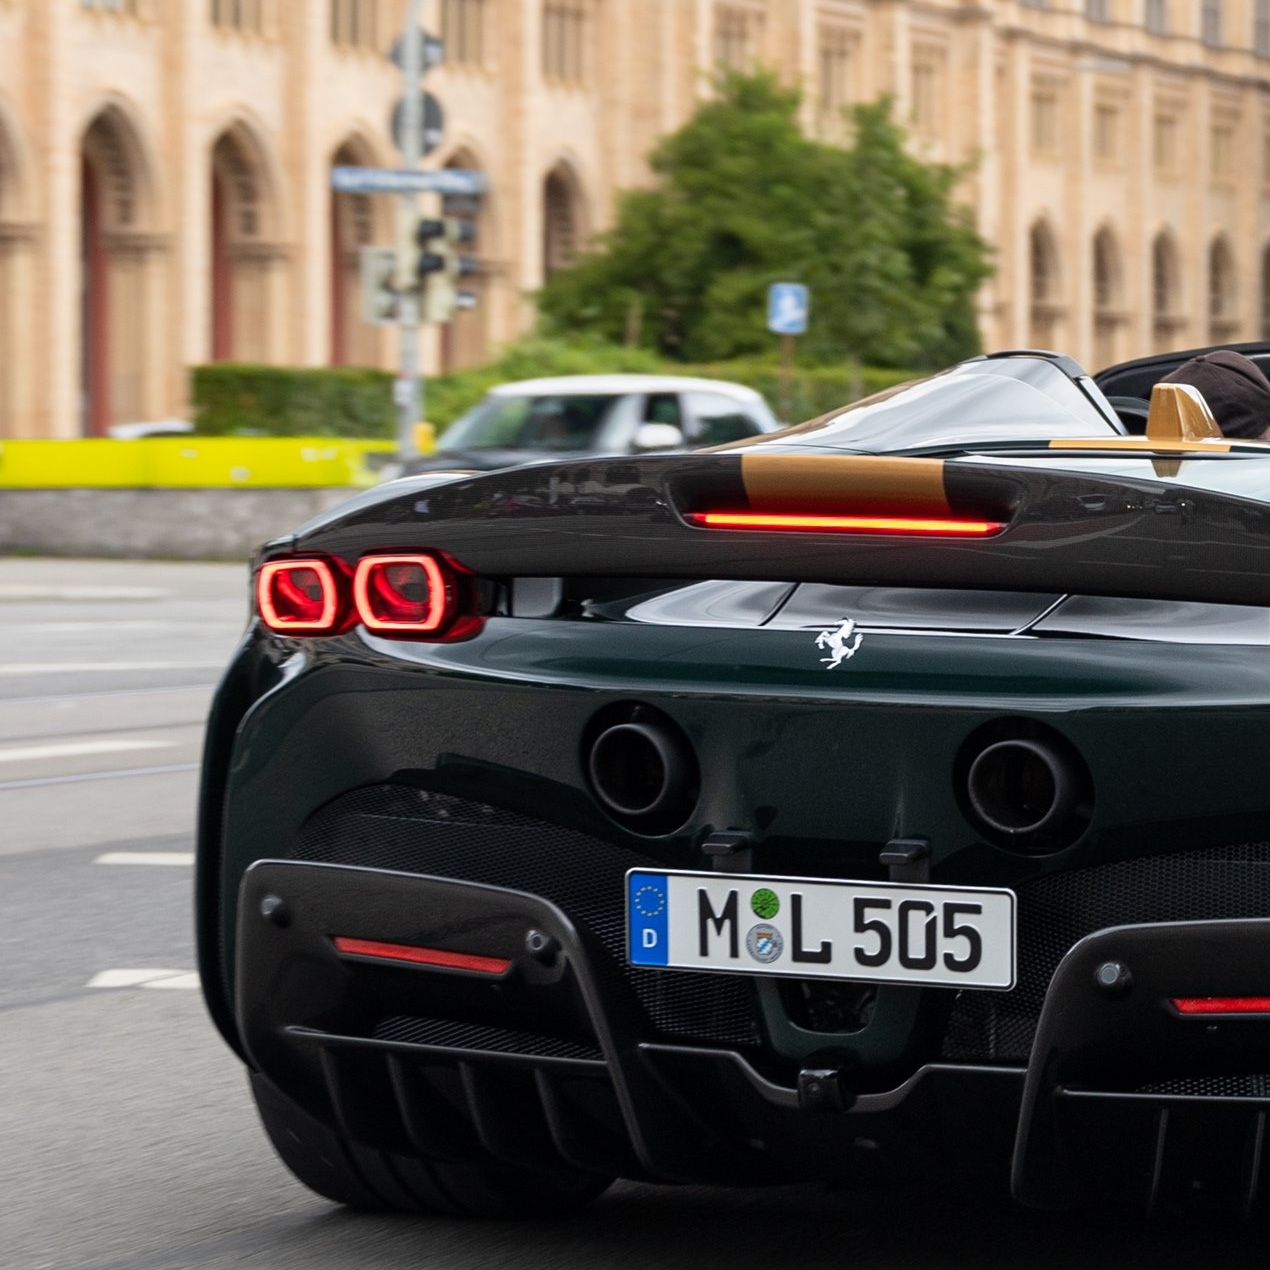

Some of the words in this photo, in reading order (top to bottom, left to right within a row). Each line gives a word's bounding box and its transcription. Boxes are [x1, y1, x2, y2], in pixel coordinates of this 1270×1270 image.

[642, 928, 658, 949] D
[698, 888, 739, 959] M
[790, 892, 832, 964] L
[853, 896, 983, 973] 505
